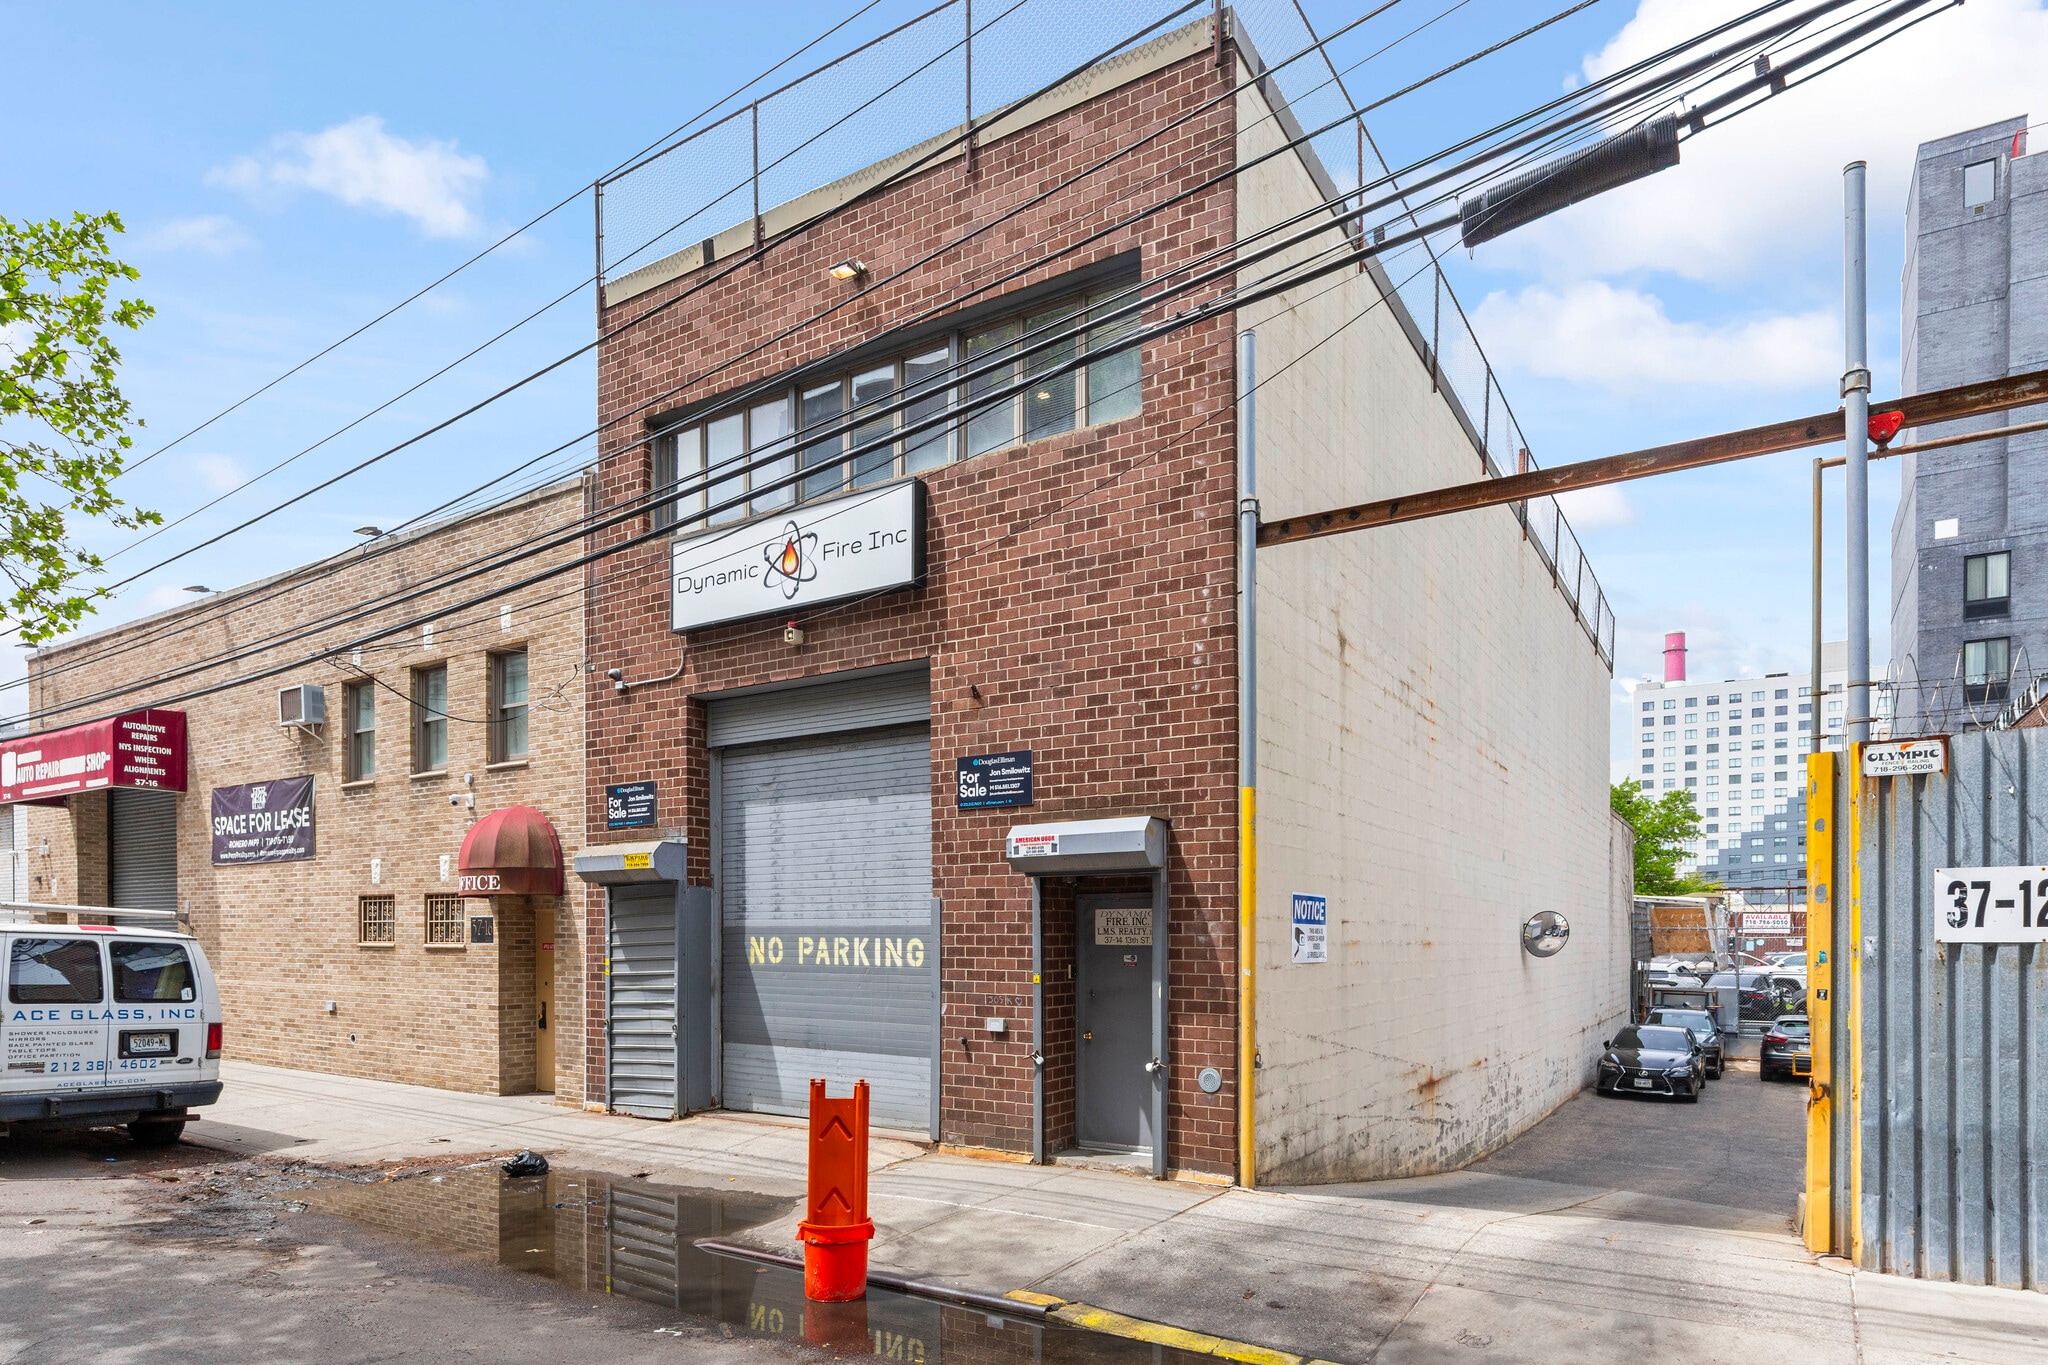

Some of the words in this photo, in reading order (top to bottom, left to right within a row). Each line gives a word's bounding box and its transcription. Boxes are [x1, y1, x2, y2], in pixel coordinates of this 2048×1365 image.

[678, 564, 759, 594] Dynamic
[823, 541, 863, 562] Fire
[868, 528, 908, 551] Inc
[122, 721, 166, 733] AUTOMOTIVE
[131, 732, 158, 742] REPAIRS
[118, 742, 132, 751] NYS
[133, 744, 172, 755] INSPECTION
[134, 756, 158, 764] WHEEL
[1867, 748, 1940, 763] OLYMPIC
[16, 765, 35, 784] AUTO
[35, 760, 60, 781] REPAIR
[124, 765, 166, 776] ALIGNMENTS
[1001, 766, 1031, 776] Smilowitz
[1874, 764, 1933, 772] 718-296-2008
[134, 778, 158, 786] 37-16
[960, 770, 980, 784] For
[960, 783, 987, 798] Sale
[608, 797, 622, 808] For
[608, 807, 627, 819] Sale
[214, 814, 247, 836] SPACE
[248, 812, 272, 833] FOR
[274, 806, 310, 831] LEASE
[458, 874, 500, 892] FFICE
[1294, 899, 1325, 921] NOTICE
[1946, 879, 2048, 929] 37-12
[1132, 917, 1150, 926] INC.
[1104, 936, 1123, 944] 37-14
[1125, 936, 1139, 944] 13th
[750, 936, 784, 964] NO
[798, 936, 925, 967] PARKING
[12, 1010, 60, 1021] ACE
[71, 1009, 152, 1021] GLASS,
[161, 1008, 195, 1019] INC
[50, 1062, 80, 1072] 212
[86, 1060, 112, 1071] 381
[120, 1059, 157, 1070] 4602
[57, 1078, 146, 1087] ACEGLASSNYC.COM
